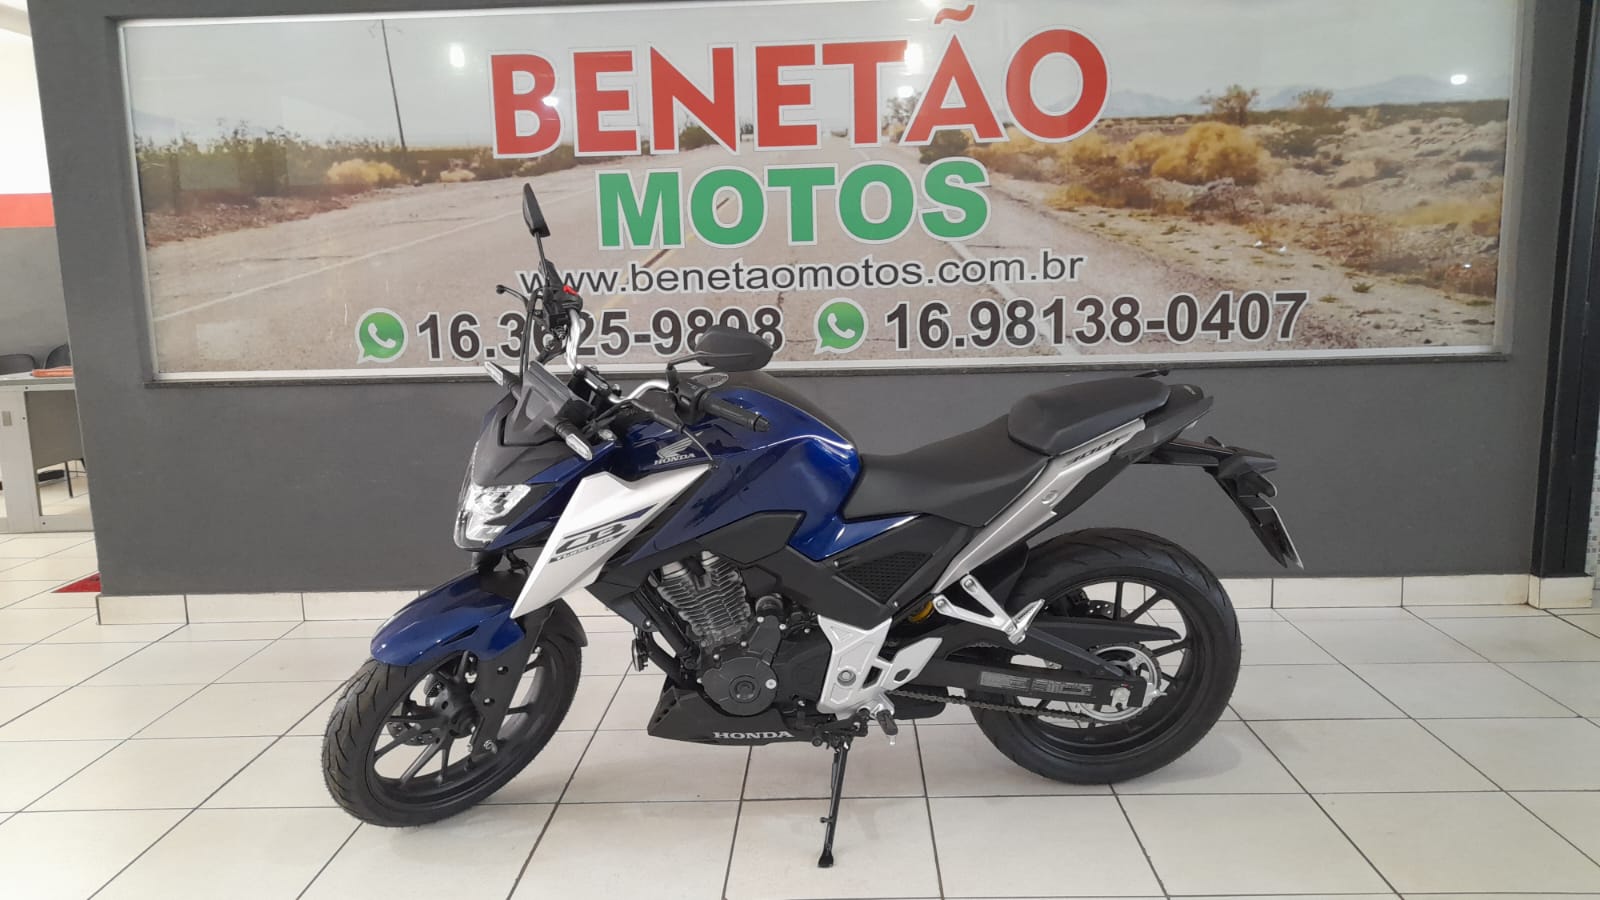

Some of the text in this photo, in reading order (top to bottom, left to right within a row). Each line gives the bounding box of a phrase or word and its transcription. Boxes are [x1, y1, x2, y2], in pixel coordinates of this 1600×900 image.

[491, 5, 1108, 156] BENETÃO
[599, 160, 991, 247] MOTOS
[519, 251, 1083, 293] www.benetaomotos.com.br
[886, 291, 1308, 349] 16.98138-0407
[653, 452, 697, 465] HONDA
[712, 730, 796, 740] HONDA
